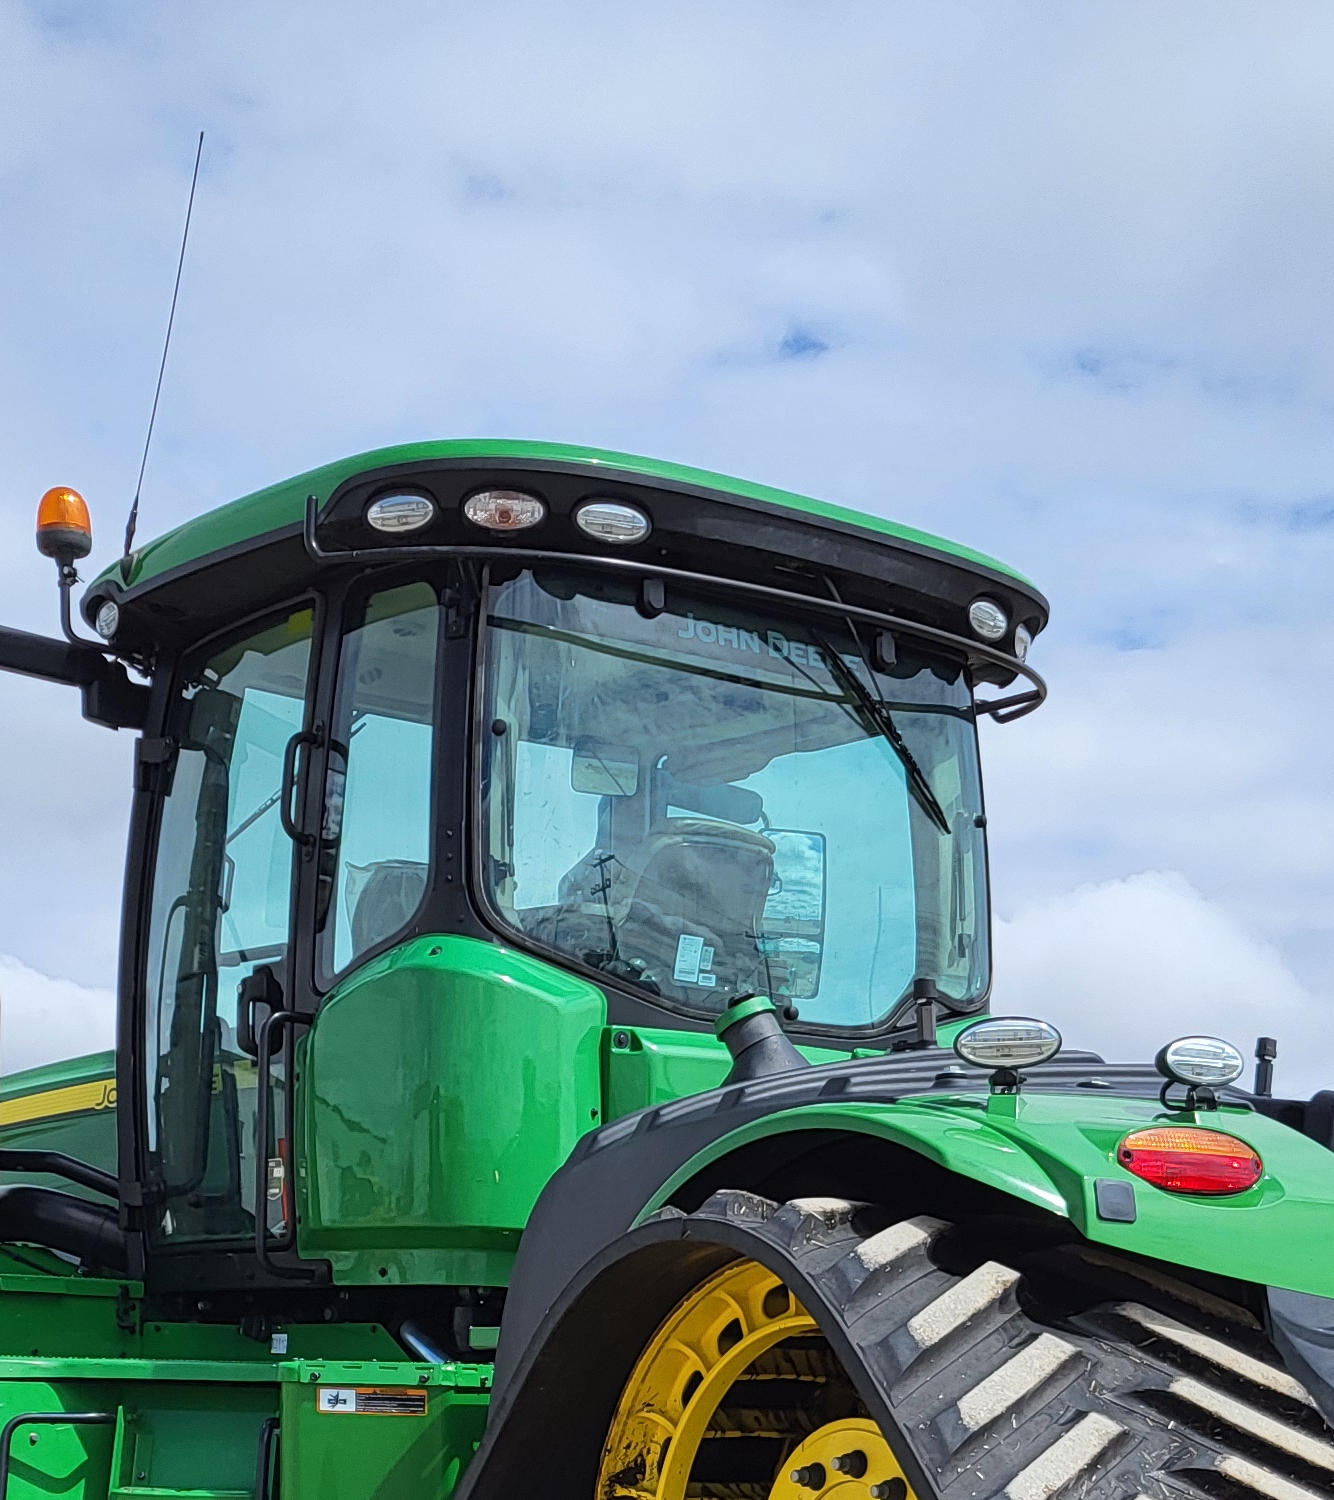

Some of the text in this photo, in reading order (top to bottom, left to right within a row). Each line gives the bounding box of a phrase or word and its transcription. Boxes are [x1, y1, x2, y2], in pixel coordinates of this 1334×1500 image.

[677, 612, 862, 678] JOHN DEEE
[95, 1084, 117, 1107] JO
